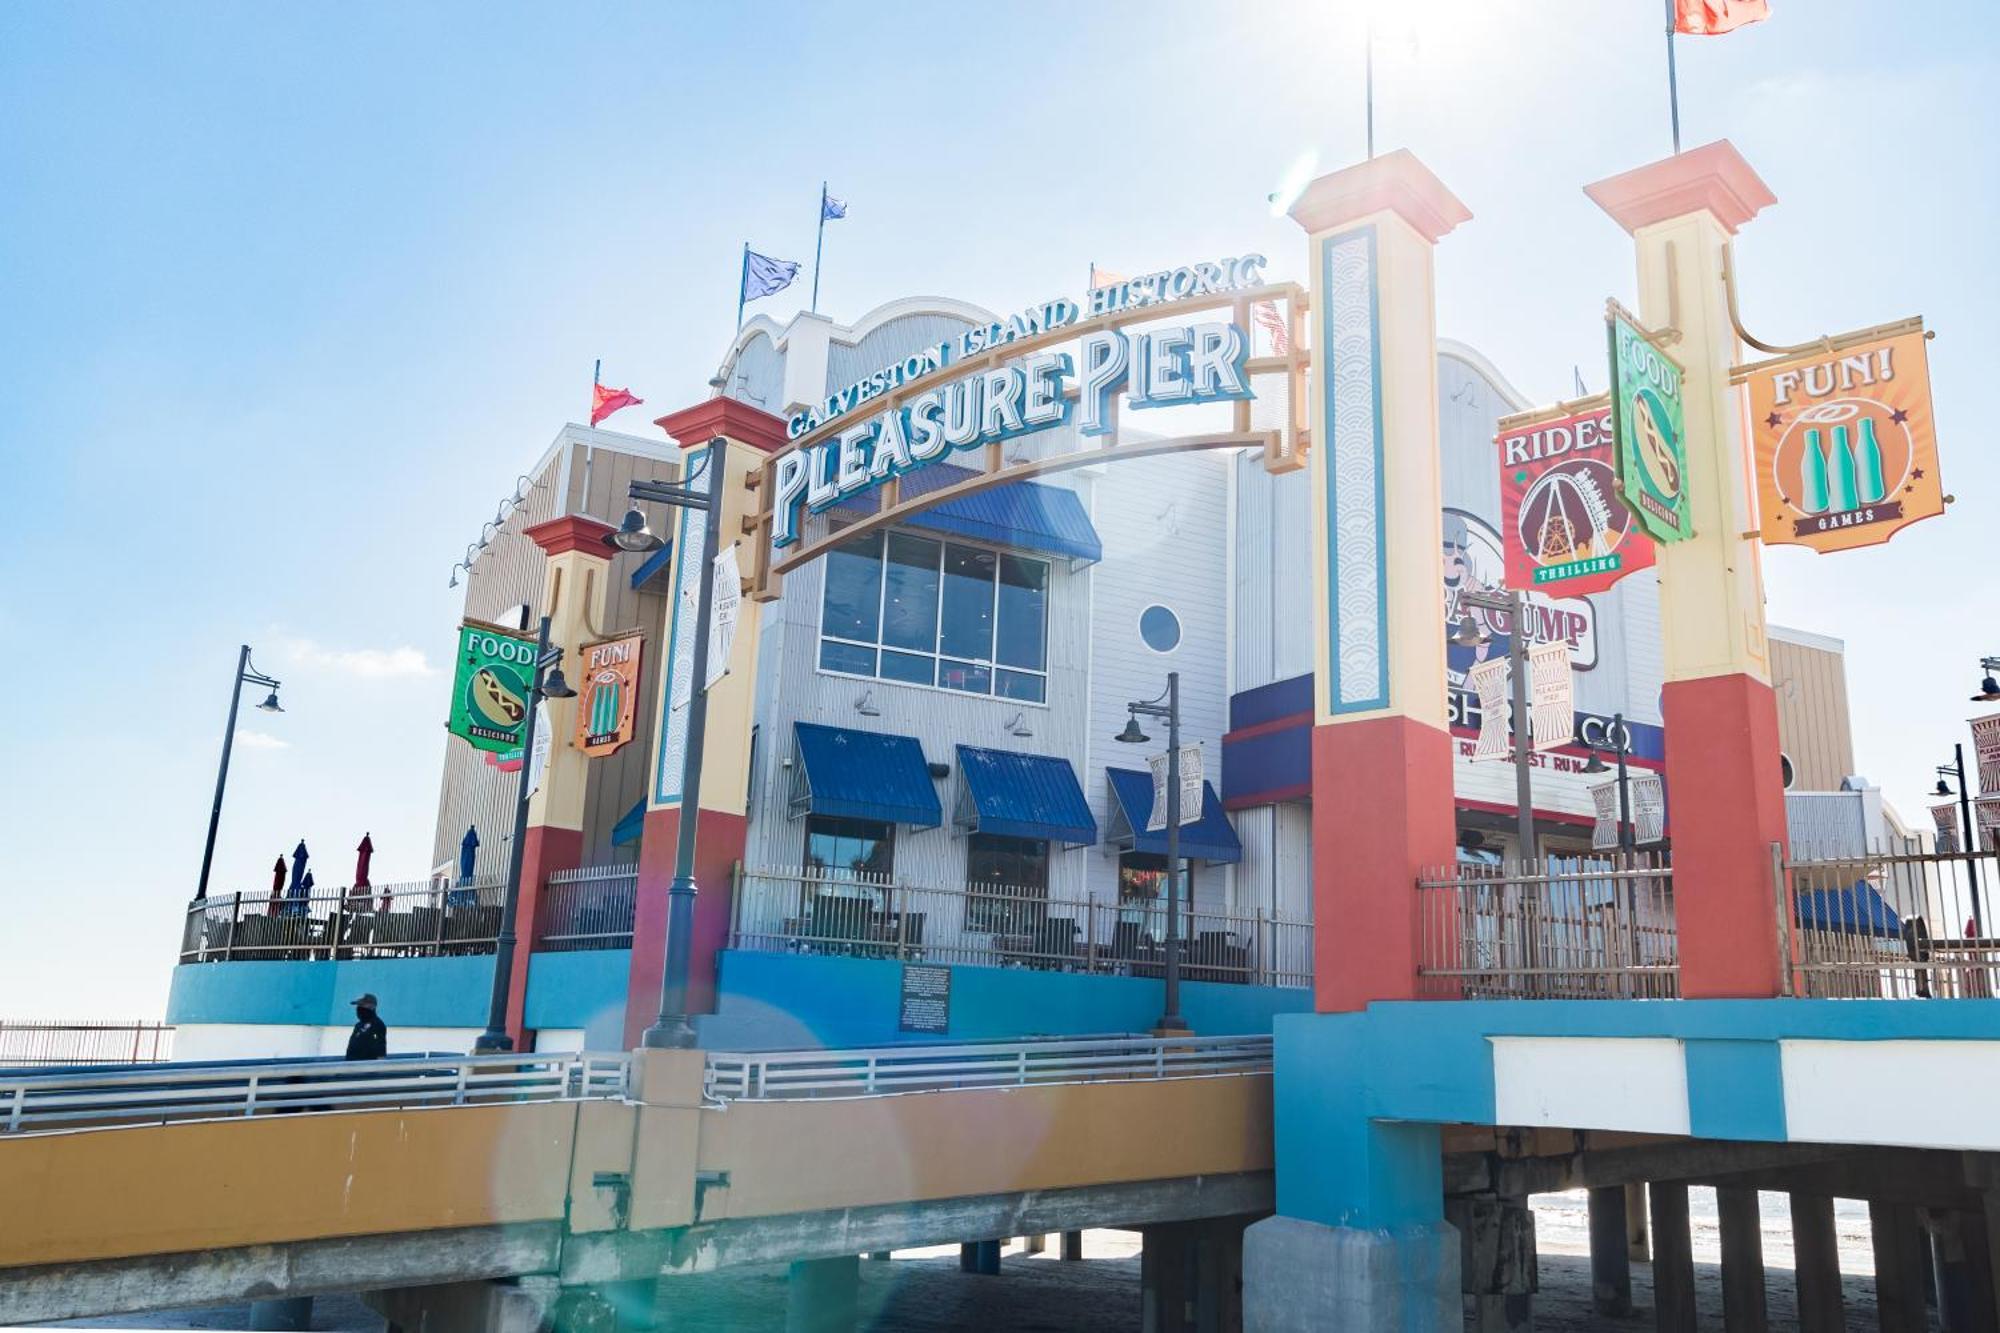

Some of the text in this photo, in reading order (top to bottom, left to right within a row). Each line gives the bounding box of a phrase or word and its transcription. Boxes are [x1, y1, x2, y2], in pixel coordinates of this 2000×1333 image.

[786, 253, 1268, 440] GALVESTON ISLAND HISTORIC
[1621, 331, 1679, 398] FOOD!
[1772, 347, 1894, 405] FUN!
[771, 321, 1257, 548] PLEASURE PIER
[1641, 496, 1678, 529] DELICIOUS
[1818, 509, 1874, 530] GAMES
[1538, 556, 1616, 581] THRILLING
[590, 643, 630, 669] FUN!
[1581, 716, 1633, 754] CO.
[1553, 756, 1582, 773] RUN
